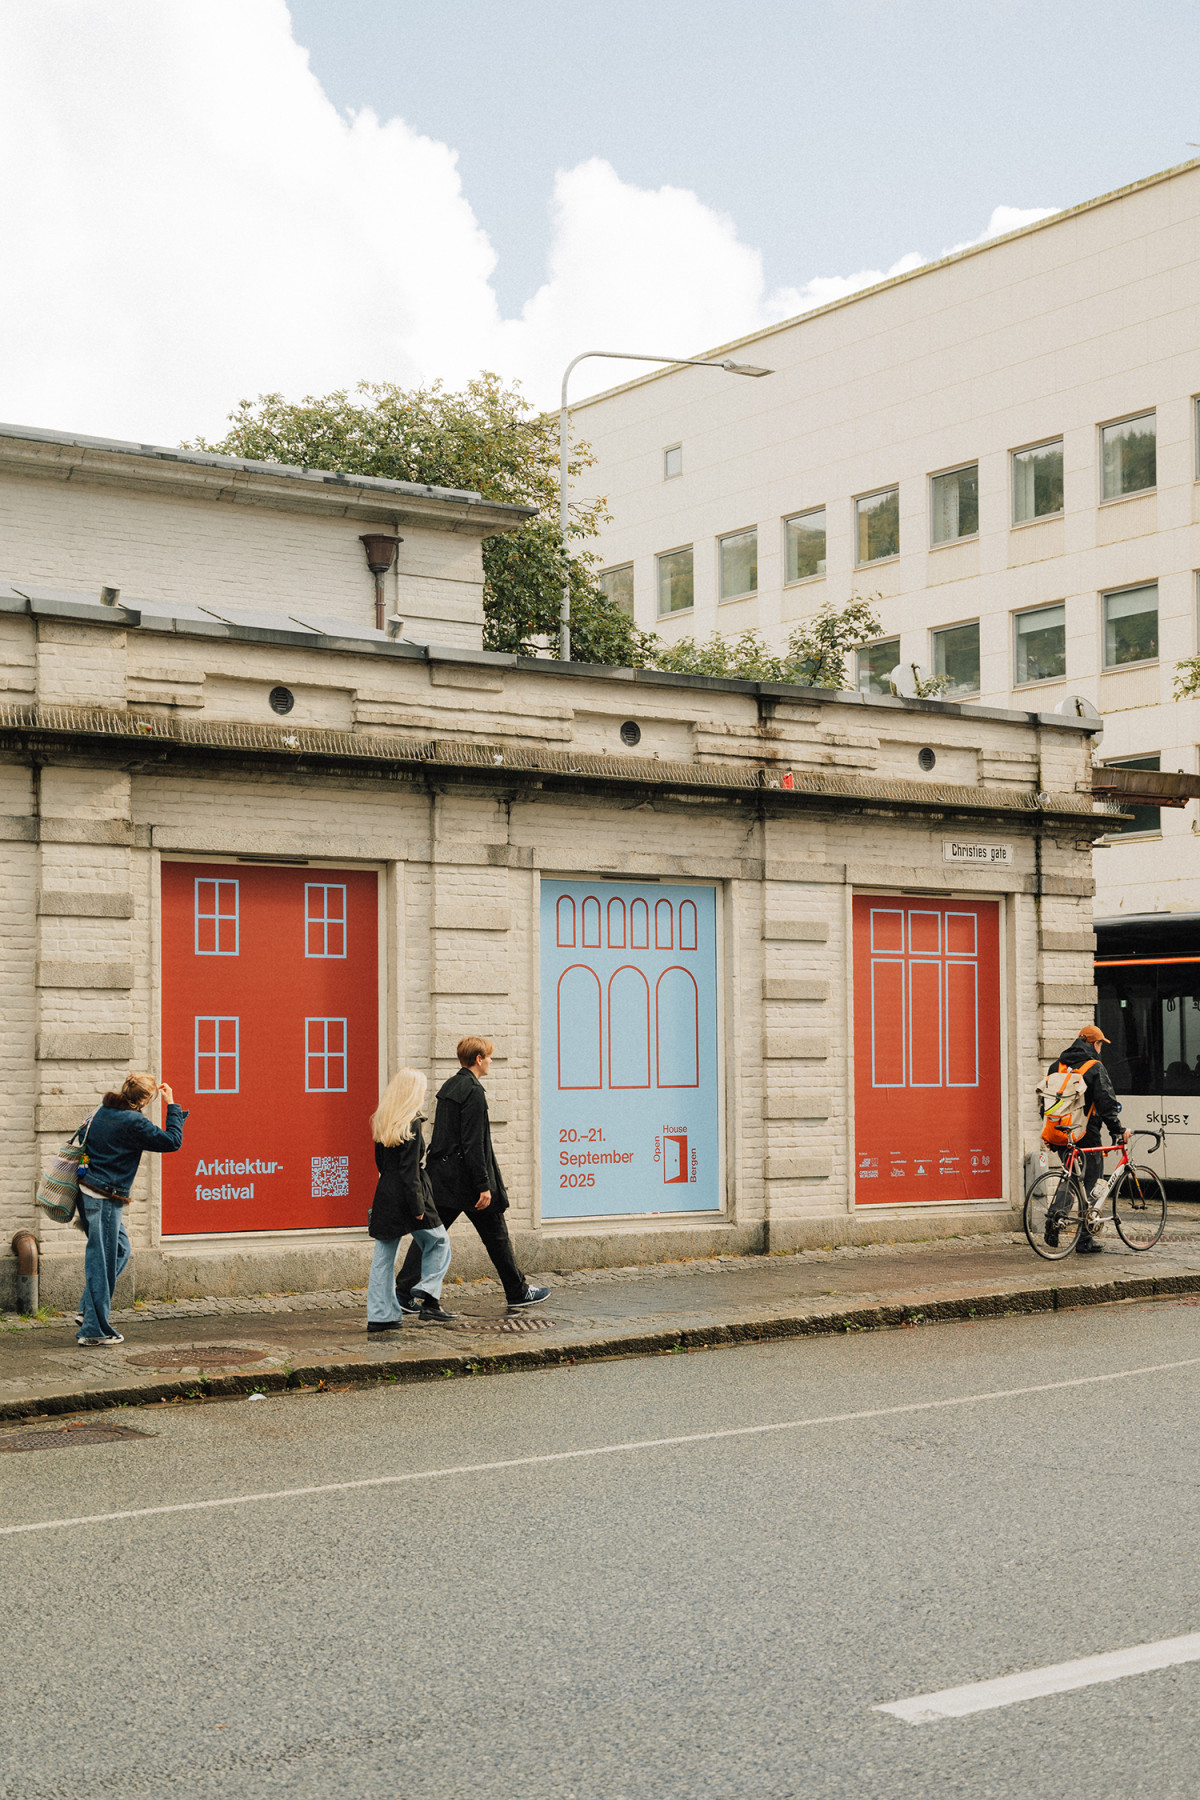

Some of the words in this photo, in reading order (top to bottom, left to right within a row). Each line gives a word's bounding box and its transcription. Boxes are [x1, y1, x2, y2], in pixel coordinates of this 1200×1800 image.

[951, 843, 987, 858] Christies
[990, 846, 1007, 861] gate
[1146, 1110, 1181, 1126] skyss
[662, 1124, 688, 1134] House
[652, 1135, 662, 1163] Open
[195, 1158, 284, 1176] Arkitektur-
[559, 1149, 634, 1168] September
[690, 1147, 698, 1183] Bergen
[559, 1173, 596, 1188] 2025
[195, 1183, 254, 1201] festival
